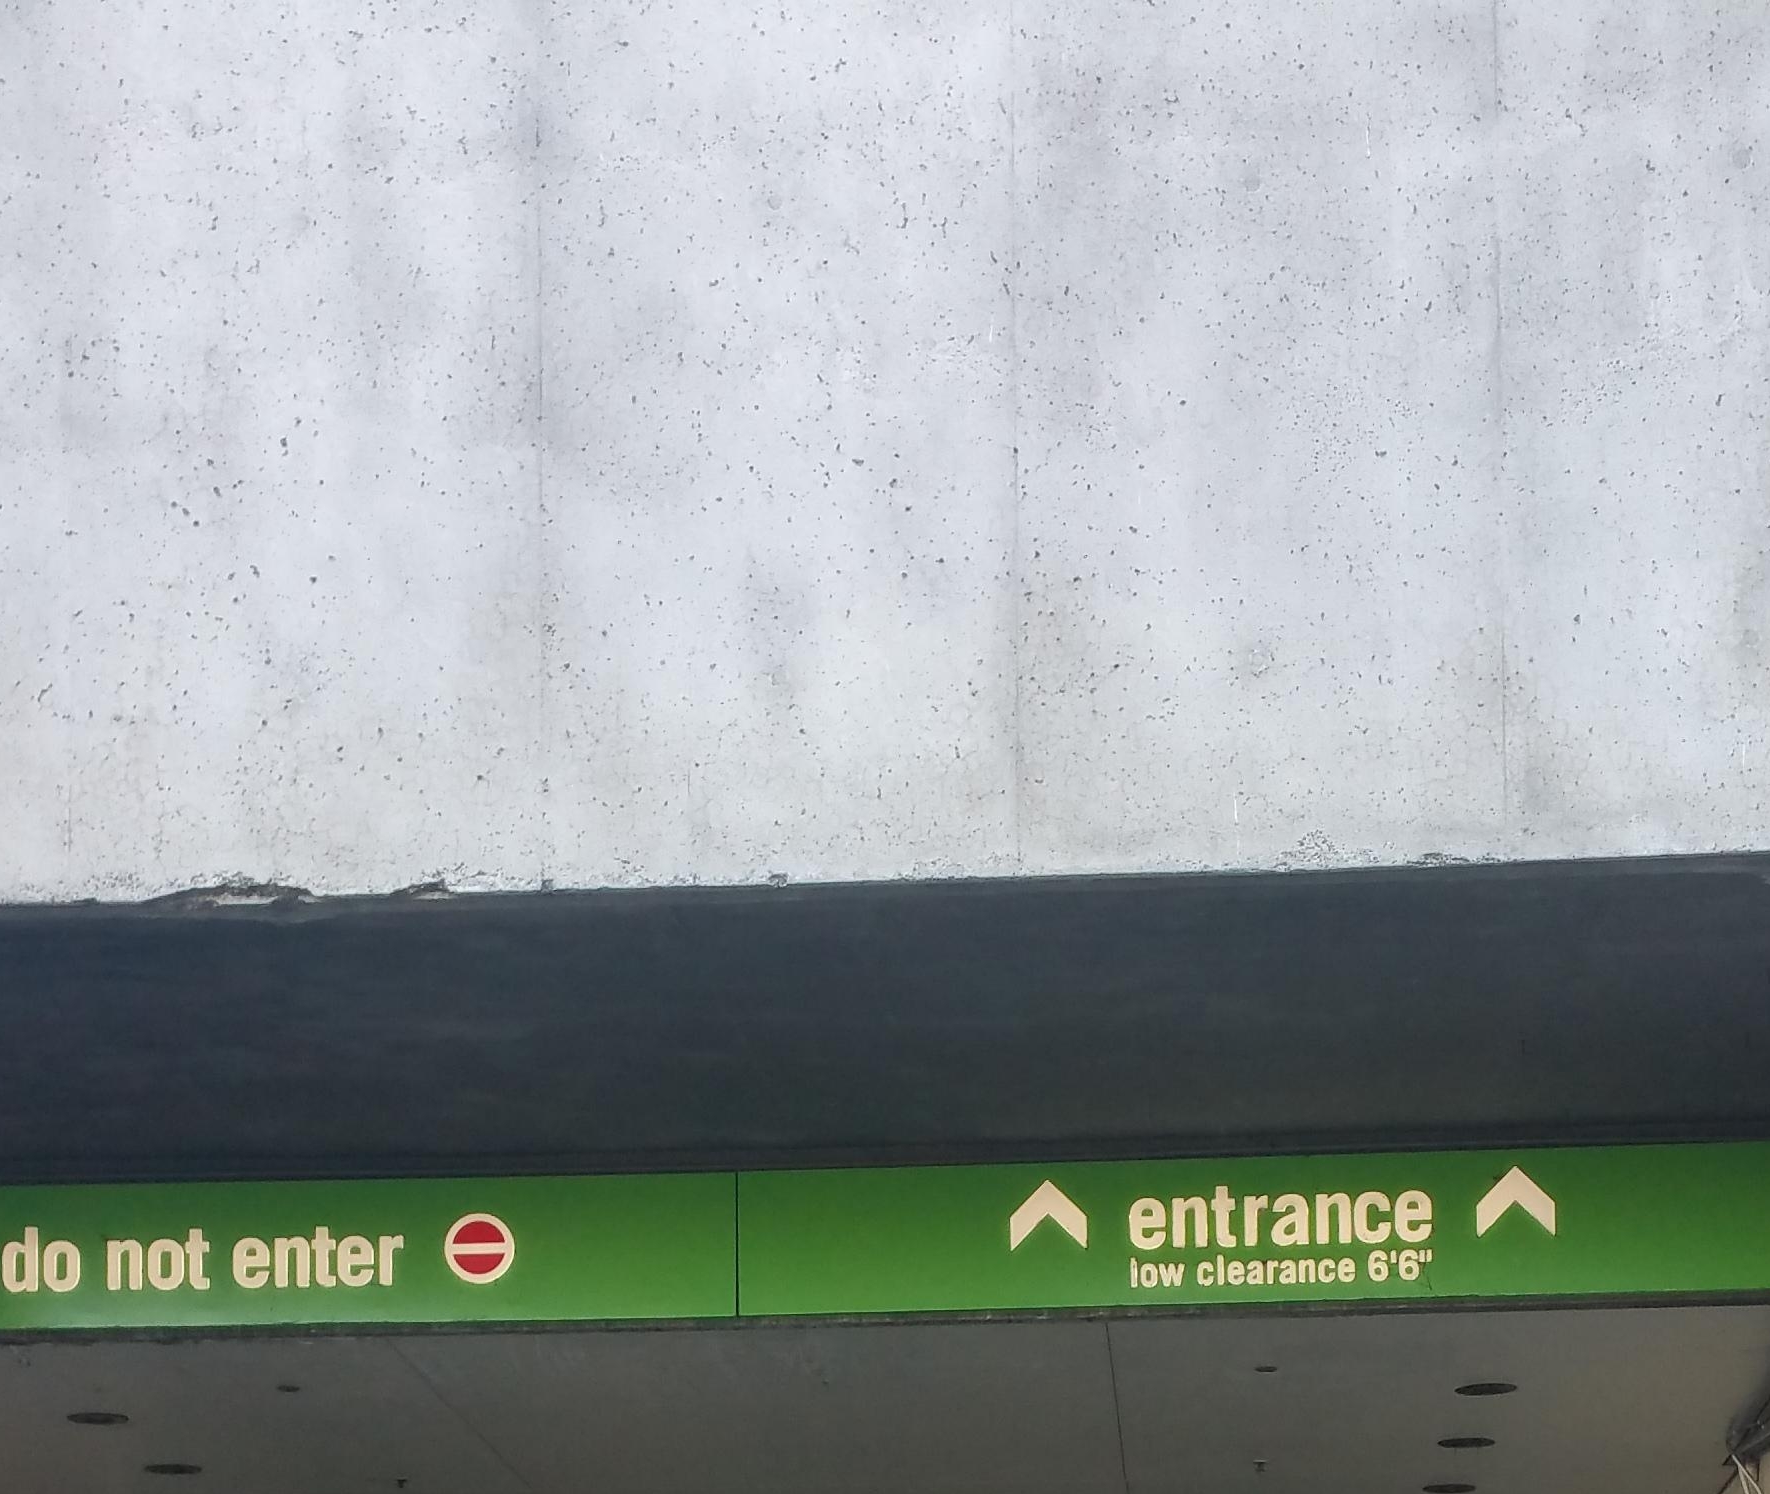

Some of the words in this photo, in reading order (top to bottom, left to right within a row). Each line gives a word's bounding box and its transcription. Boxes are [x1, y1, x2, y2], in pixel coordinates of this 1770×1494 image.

[1129, 1185, 1433, 1249] entrance
[1, 1227, 80, 1293] do
[107, 1228, 210, 1290] not
[233, 1226, 404, 1288] enter
[1130, 1256, 1185, 1288] low
[1196, 1254, 1356, 1287] clearance
